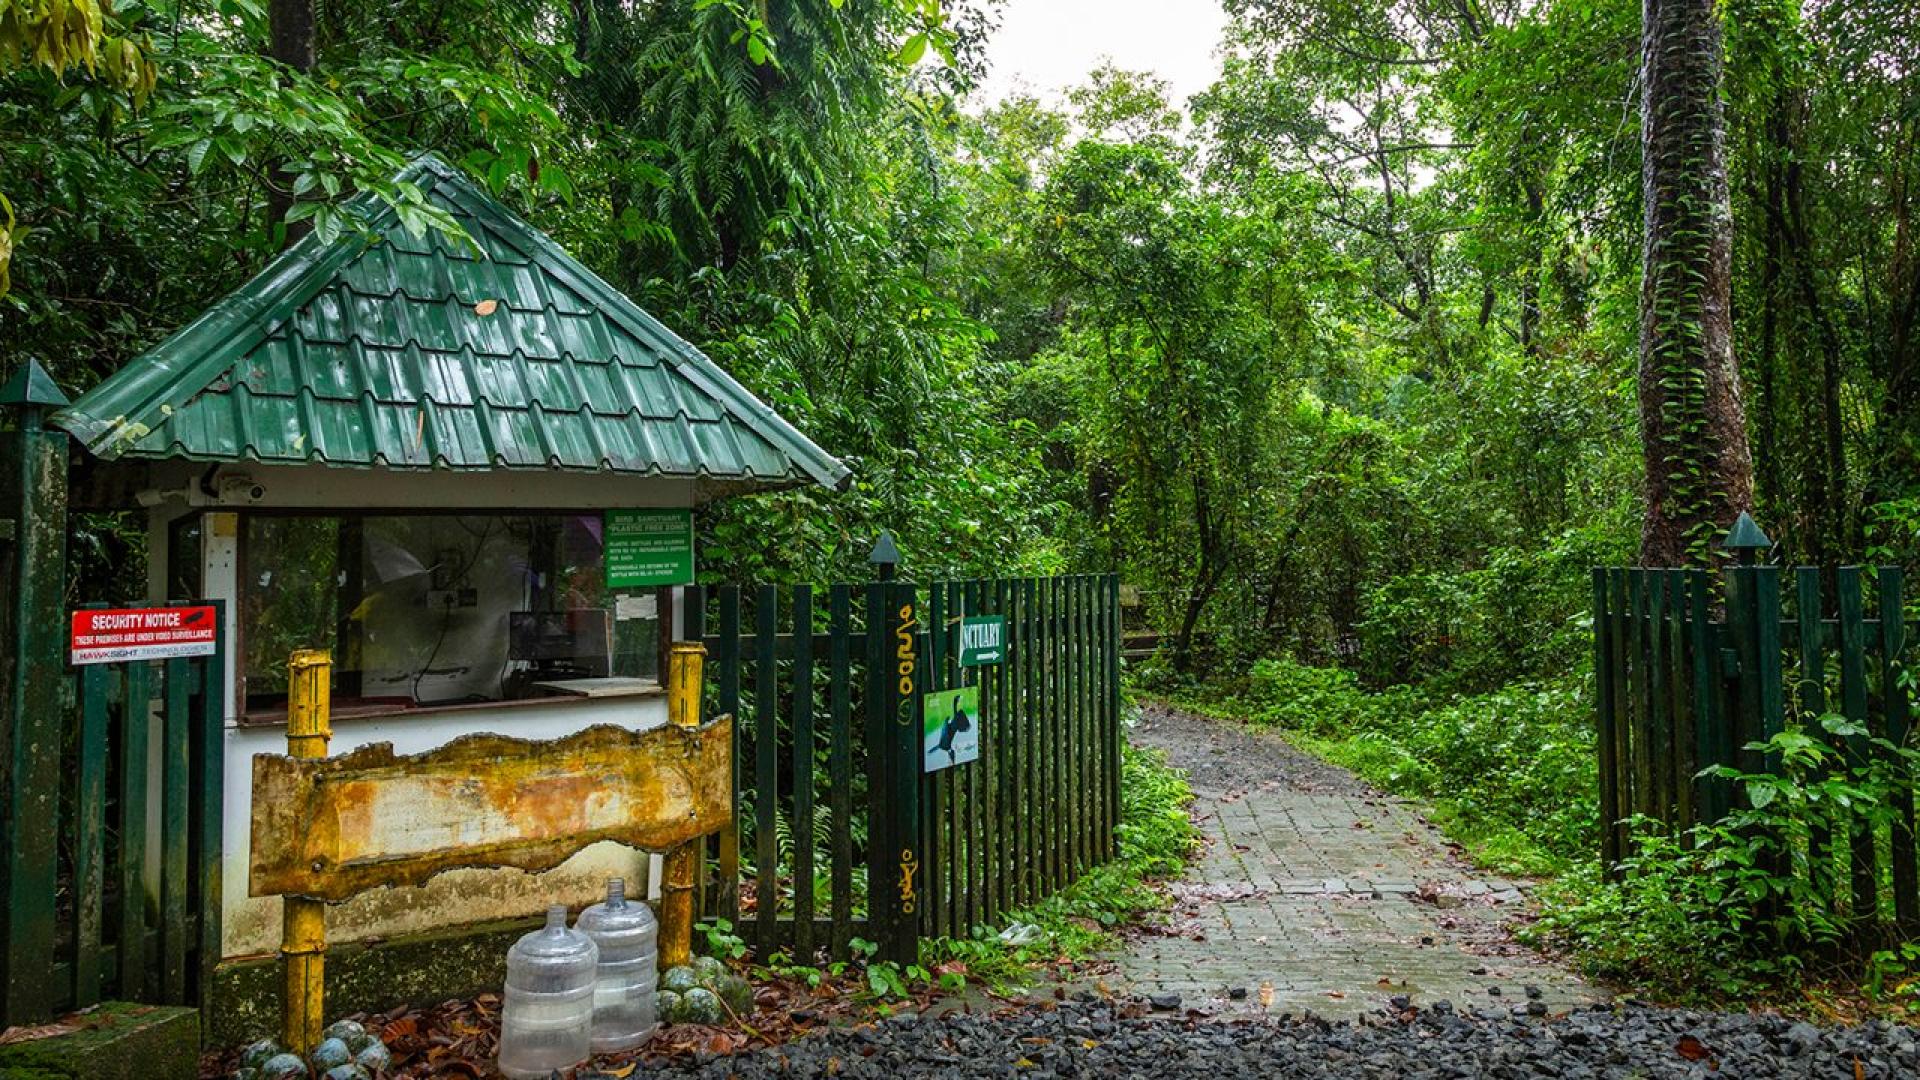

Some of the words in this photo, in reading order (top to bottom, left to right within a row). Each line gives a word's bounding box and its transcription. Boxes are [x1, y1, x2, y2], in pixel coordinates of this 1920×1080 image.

[638, 515, 681, 523] SANCTUARY
[92, 614, 142, 630] SECURITY
[145, 613, 181, 627] NOTICE
[75, 635, 94, 646] THESE
[96, 633, 123, 644] PREMISES
[124, 633, 136, 643] ARE
[137, 632, 154, 642] UNDER
[155, 631, 172, 641] VIDEO
[172, 629, 213, 640] SURVEILLANCE
[79, 649, 138, 660] HAWKSIGHT
[141, 644, 208, 656] TECHNOLOGIES
